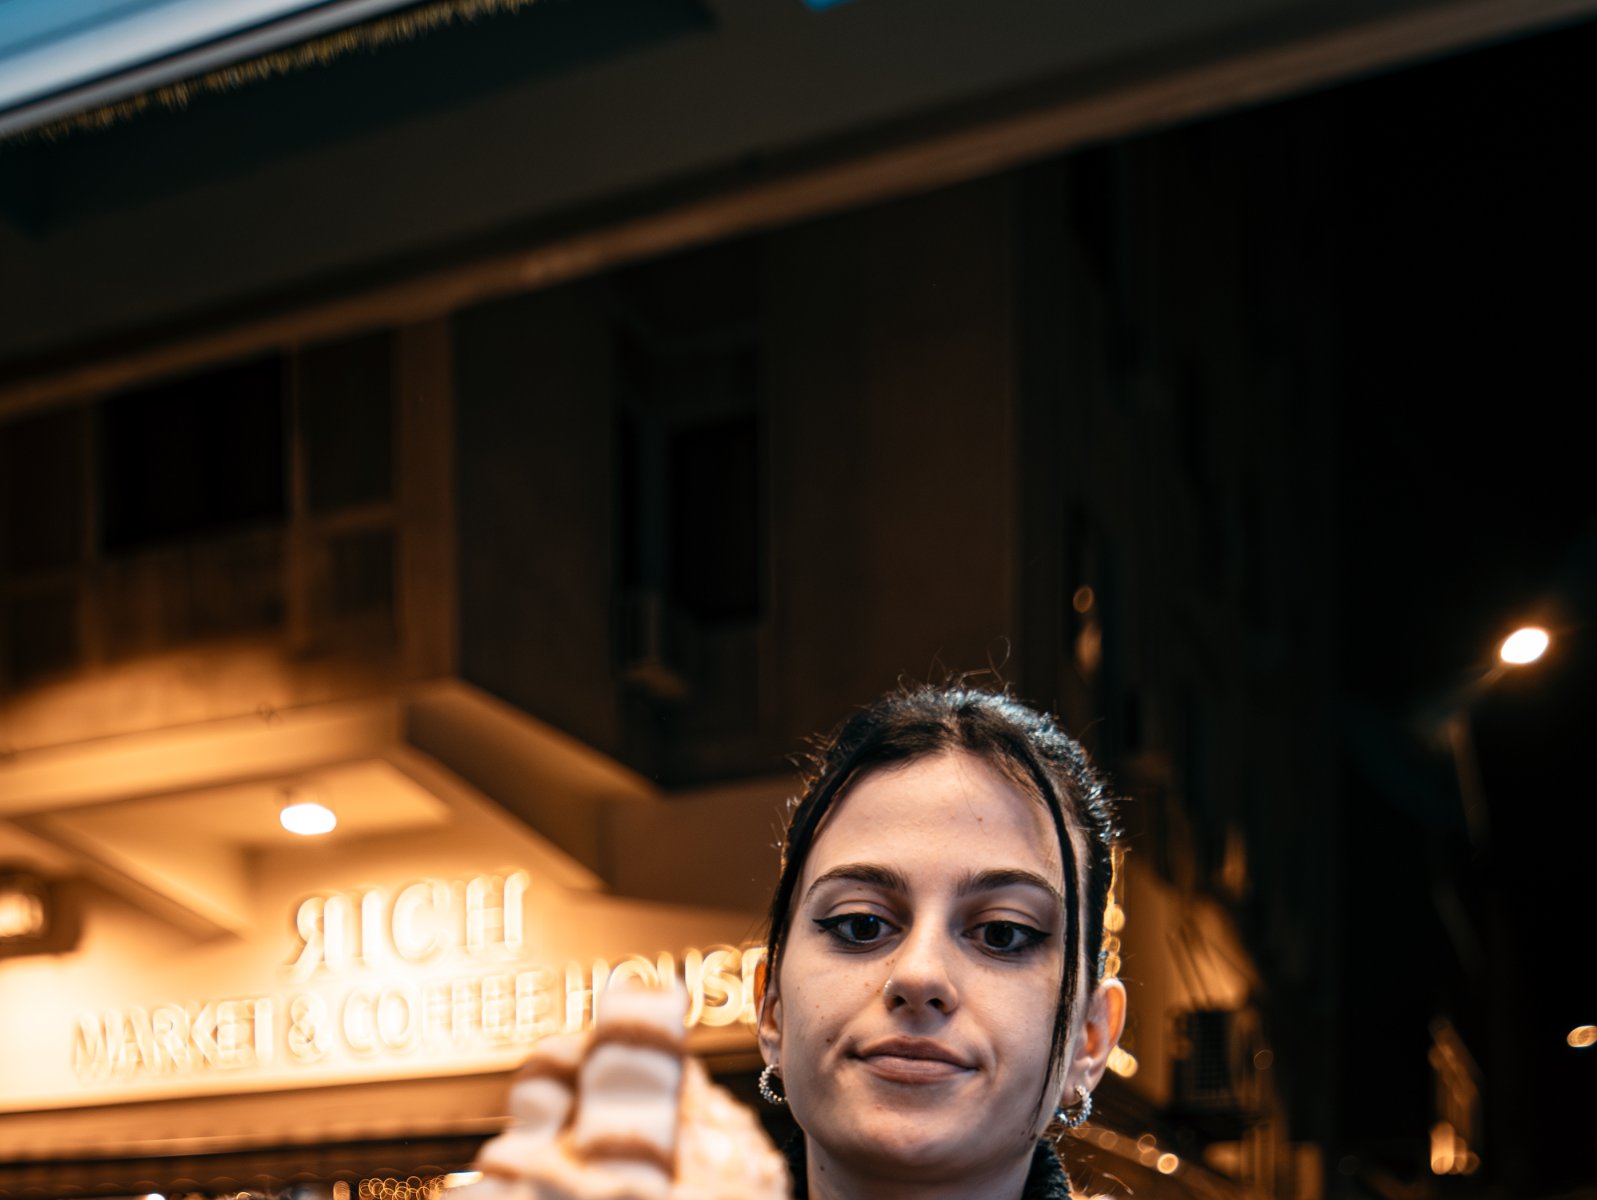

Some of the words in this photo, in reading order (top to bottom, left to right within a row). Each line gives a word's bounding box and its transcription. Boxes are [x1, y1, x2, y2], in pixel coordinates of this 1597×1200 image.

[70, 994, 281, 1078] MARKET
[286, 992, 332, 1063] &
[342, 970, 556, 1058] COFFEE
